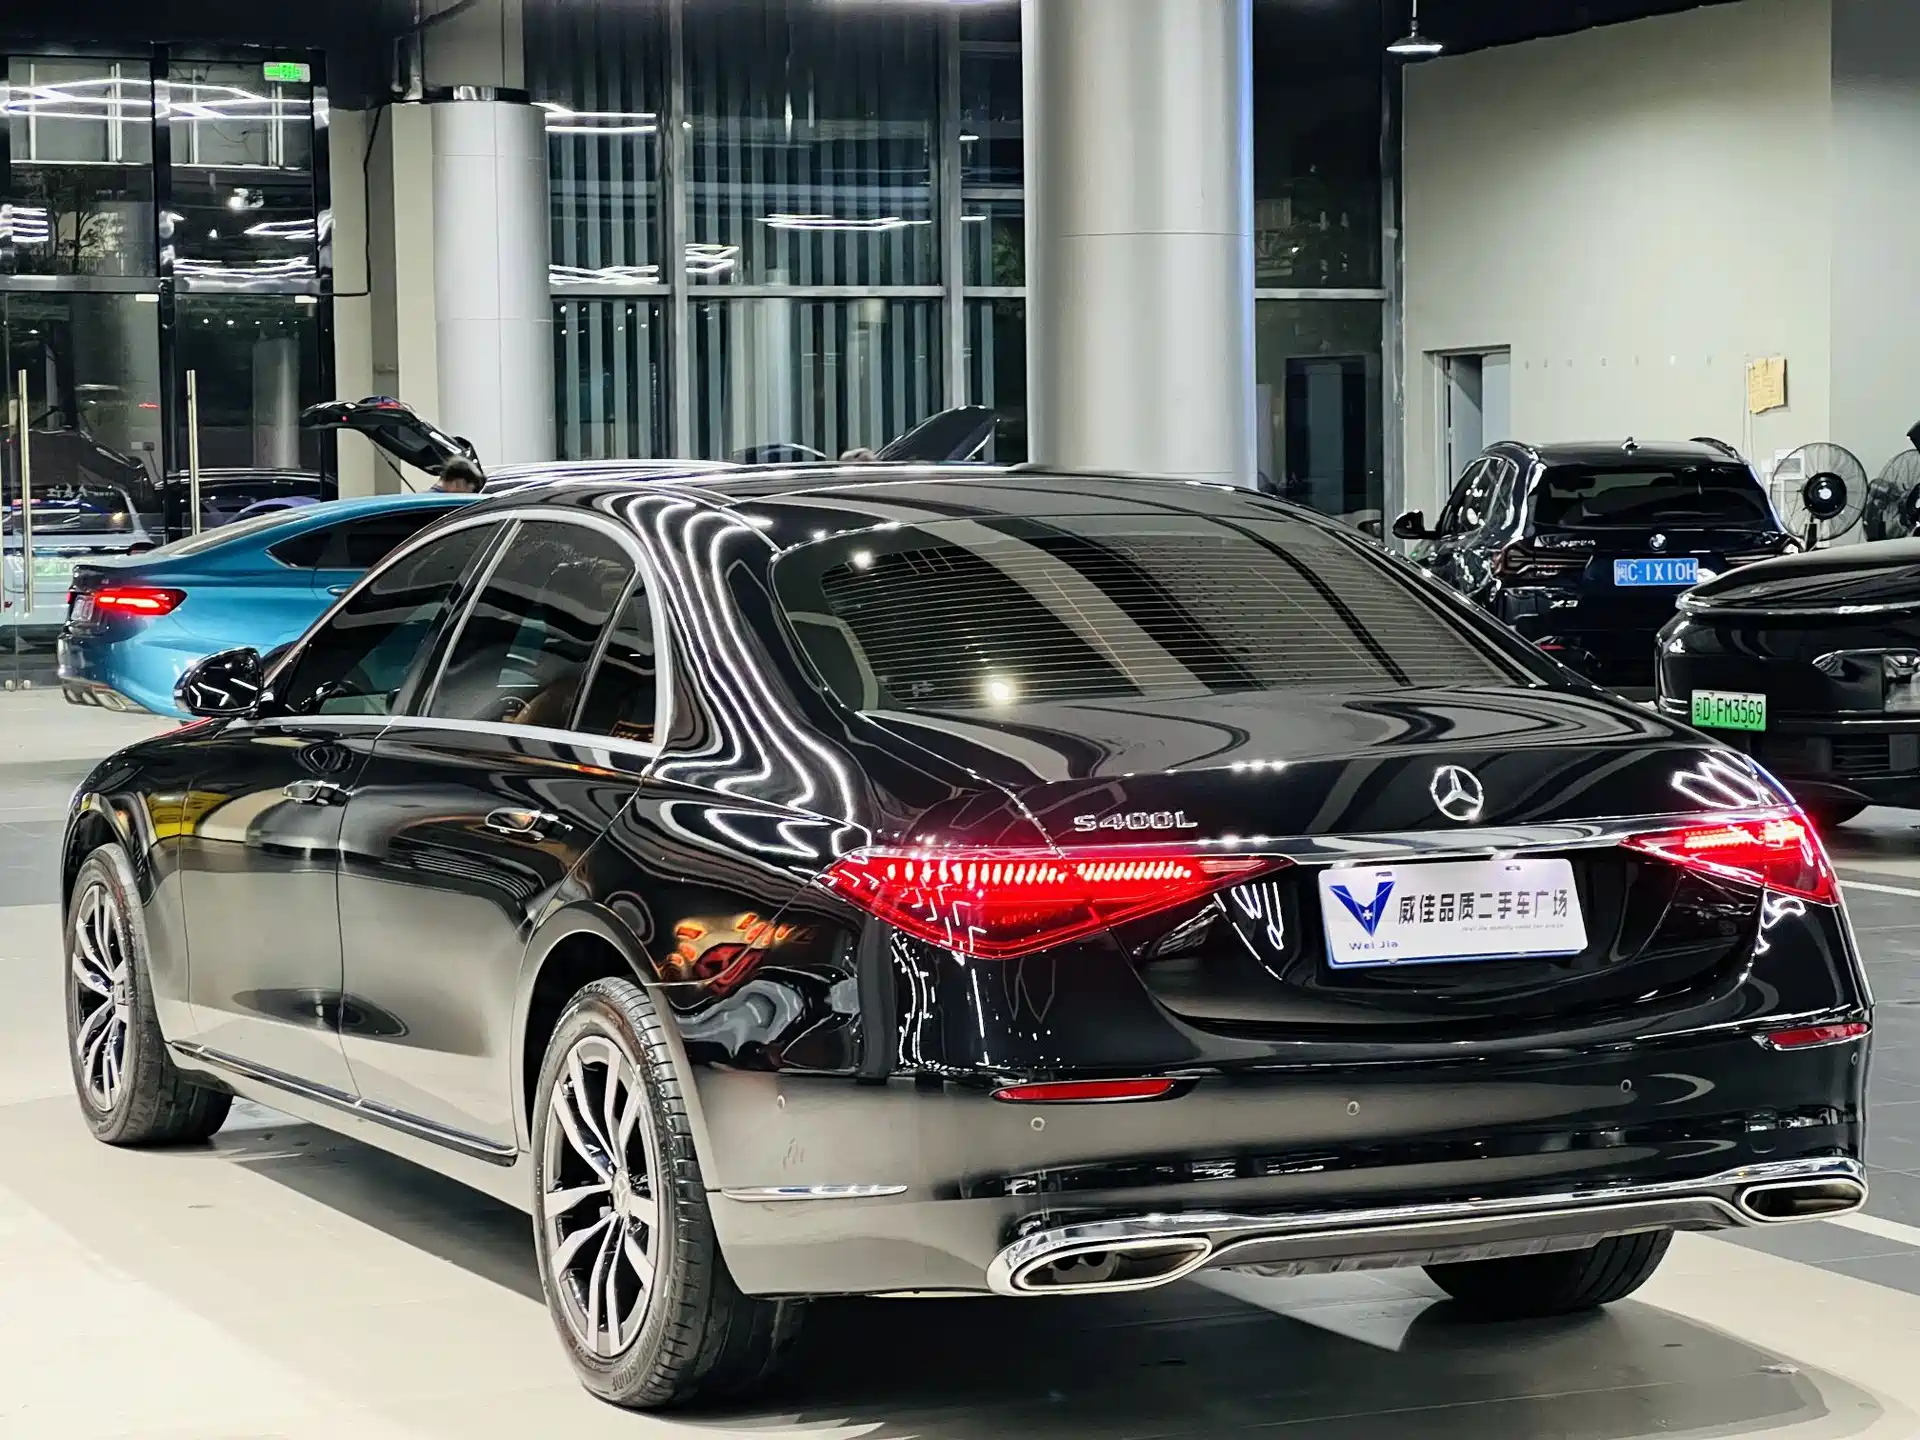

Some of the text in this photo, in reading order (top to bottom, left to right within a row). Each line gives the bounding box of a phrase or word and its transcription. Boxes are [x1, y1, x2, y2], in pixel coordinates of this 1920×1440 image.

[1073, 810, 1198, 832] S400L
[1398, 889, 1568, 925] 威佳品质二手车广场
[1348, 940, 1399, 950] Wei Jia
